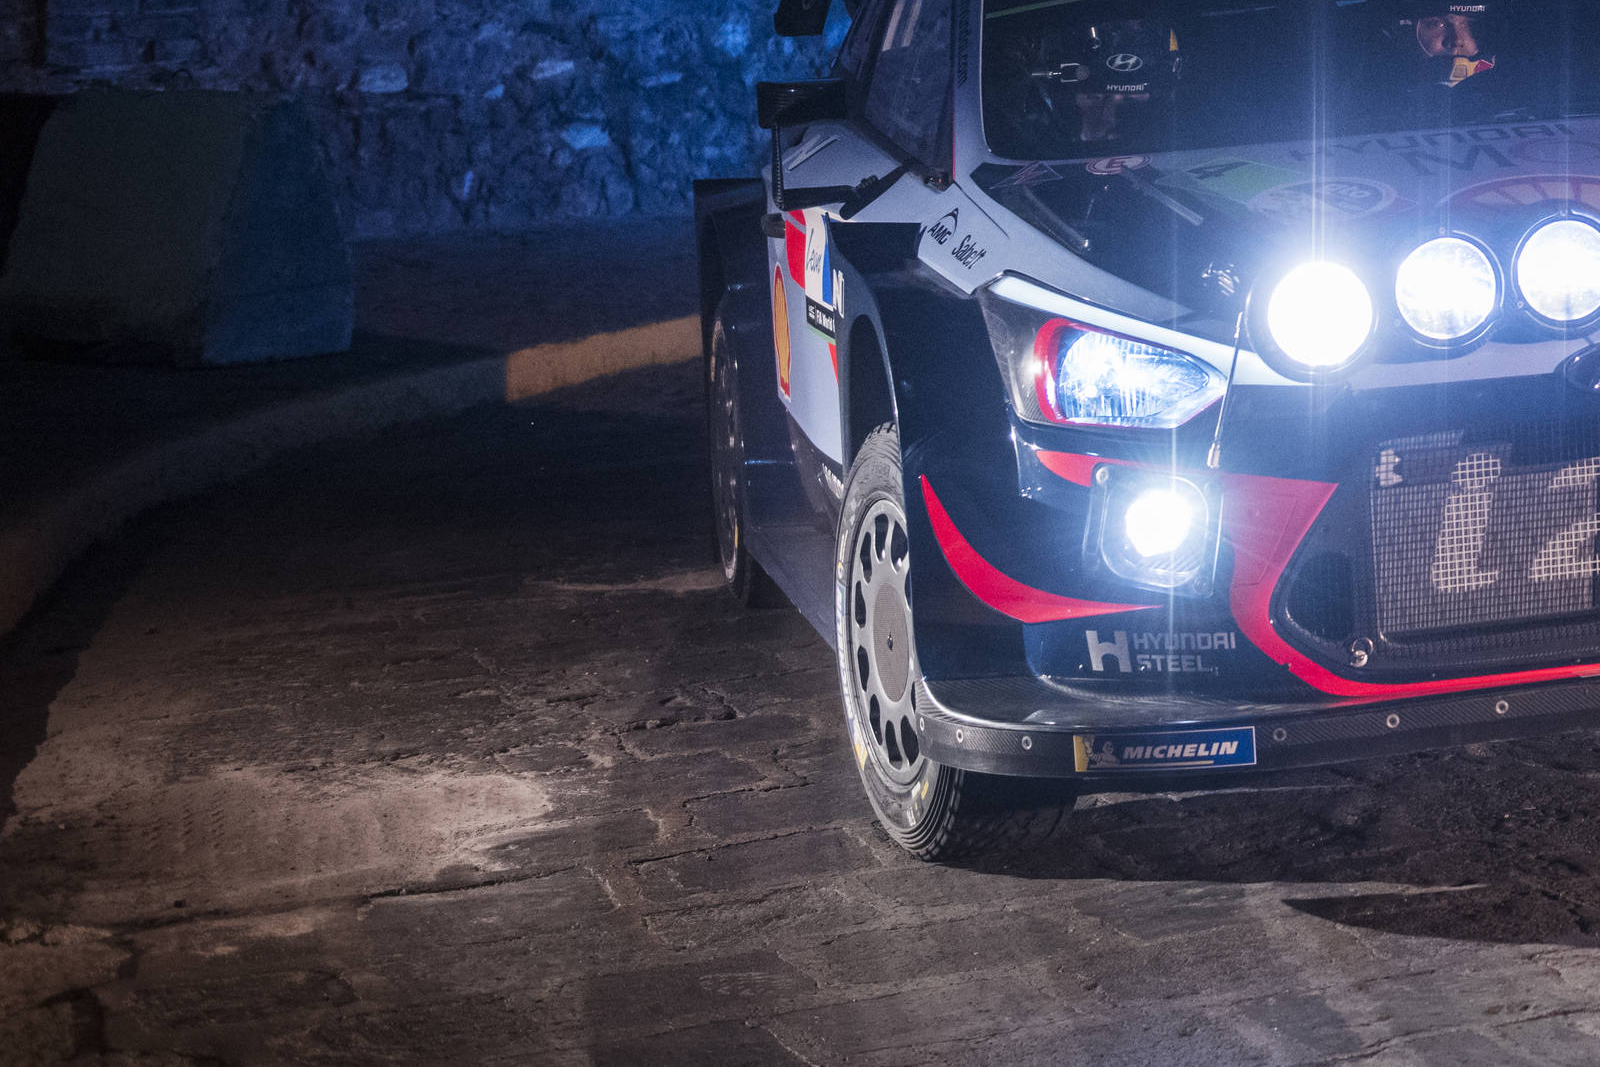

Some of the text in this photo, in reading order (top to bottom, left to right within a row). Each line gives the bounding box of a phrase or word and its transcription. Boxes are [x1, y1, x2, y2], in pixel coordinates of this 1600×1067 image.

[1106, 84, 1145, 92] HYUNDAI
[1289, 123, 1571, 161] HYUNDAI
[951, 234, 987, 269] Sabelt
[1132, 633, 1236, 650] HYUNDAI
[1136, 654, 1209, 672] STEEL
[1122, 741, 1239, 760] MICHELIN
